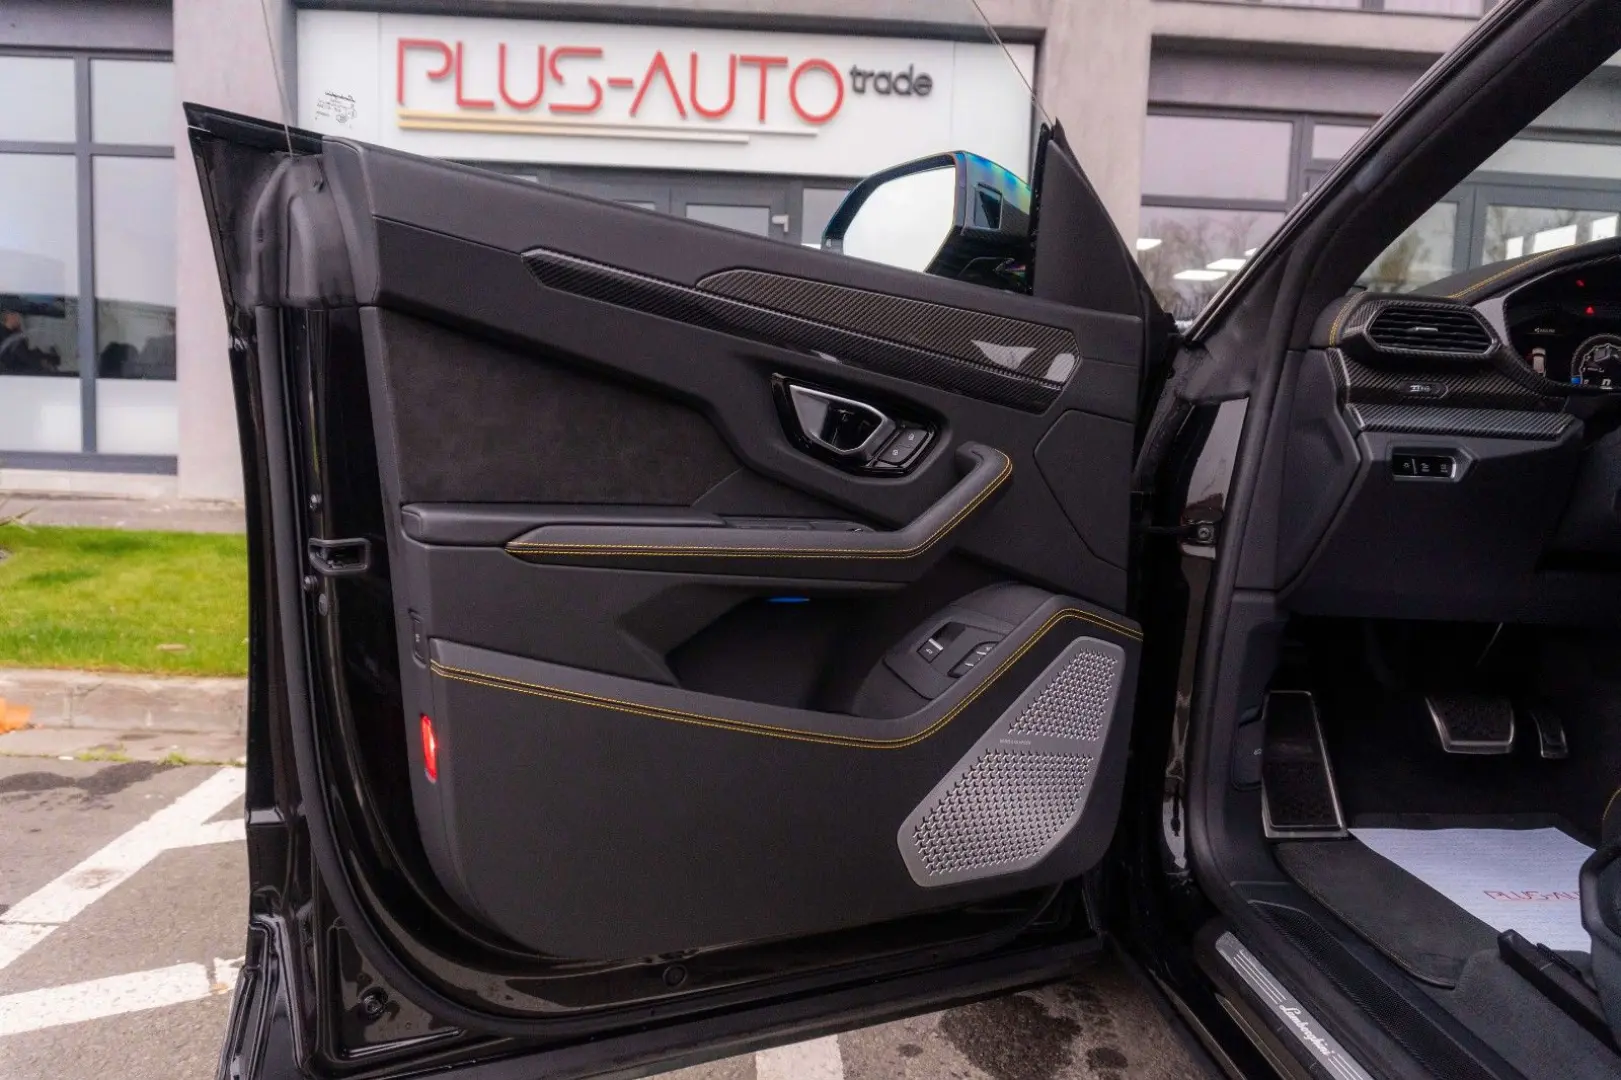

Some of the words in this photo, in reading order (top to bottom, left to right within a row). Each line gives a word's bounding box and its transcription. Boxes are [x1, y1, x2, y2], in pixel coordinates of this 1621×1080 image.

[397, 37, 845, 125] PLUS-AUTO
[849, 63, 934, 97] trade
[1482, 890, 1580, 900] PLUS-AU
[1278, 1004, 1336, 1057] Lamborghini
